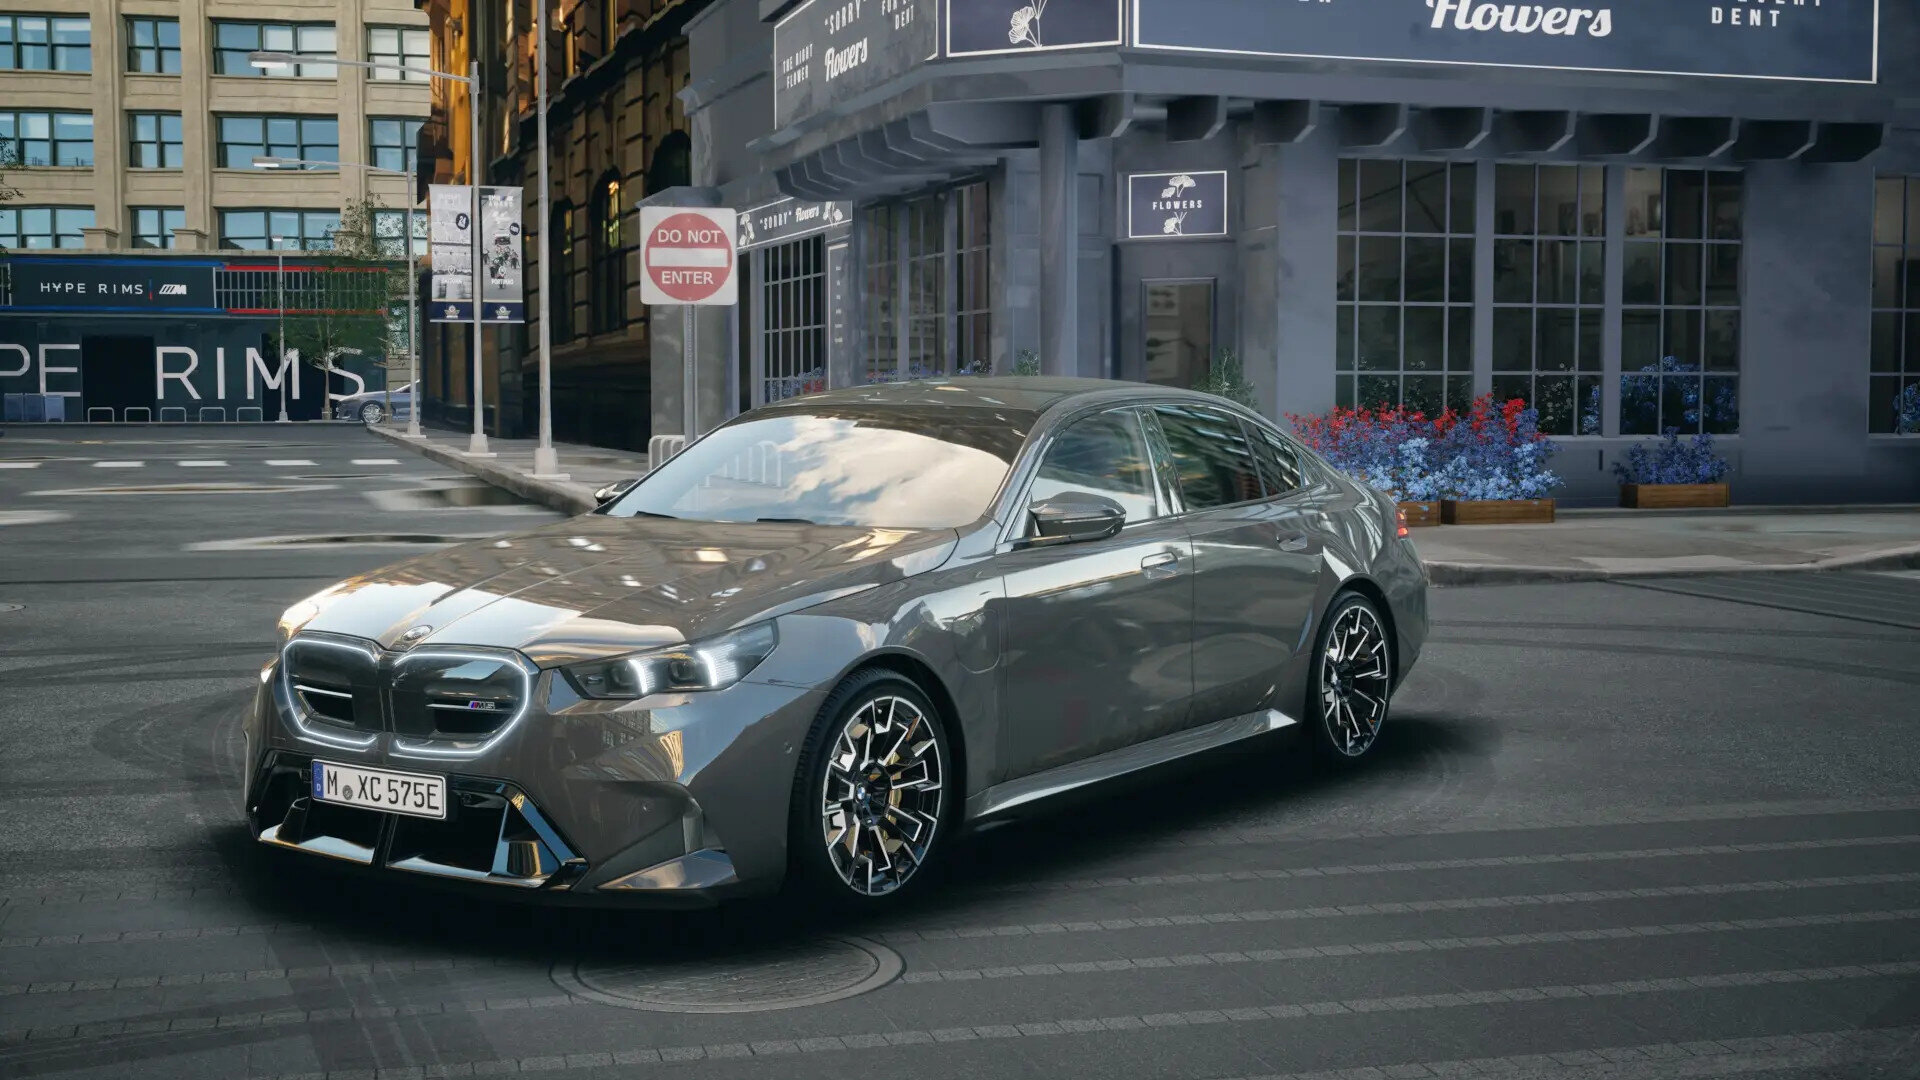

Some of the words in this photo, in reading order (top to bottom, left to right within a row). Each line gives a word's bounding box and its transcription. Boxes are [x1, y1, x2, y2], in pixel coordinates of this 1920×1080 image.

[824, 0, 866, 34] "SORRY
[895, 5, 914, 30] DENT
[1426, 0, 1612, 37] Flowers
[1711, 7, 1780, 27] DENT
[783, 56, 793, 75] THE
[786, 65, 809, 89] FLOWER
[1152, 200, 1202, 210] FLOWERS
[658, 229, 682, 243] DO
[687, 230, 722, 244] NOT
[40, 282, 86, 294] HYPE
[98, 283, 143, 295] RIMS
[661, 270, 714, 285] ENTER
[156, 346, 365, 401] RIMS
[327, 769, 338, 796] M
[358, 775, 382, 802] XC
[387, 778, 440, 810] 575E
